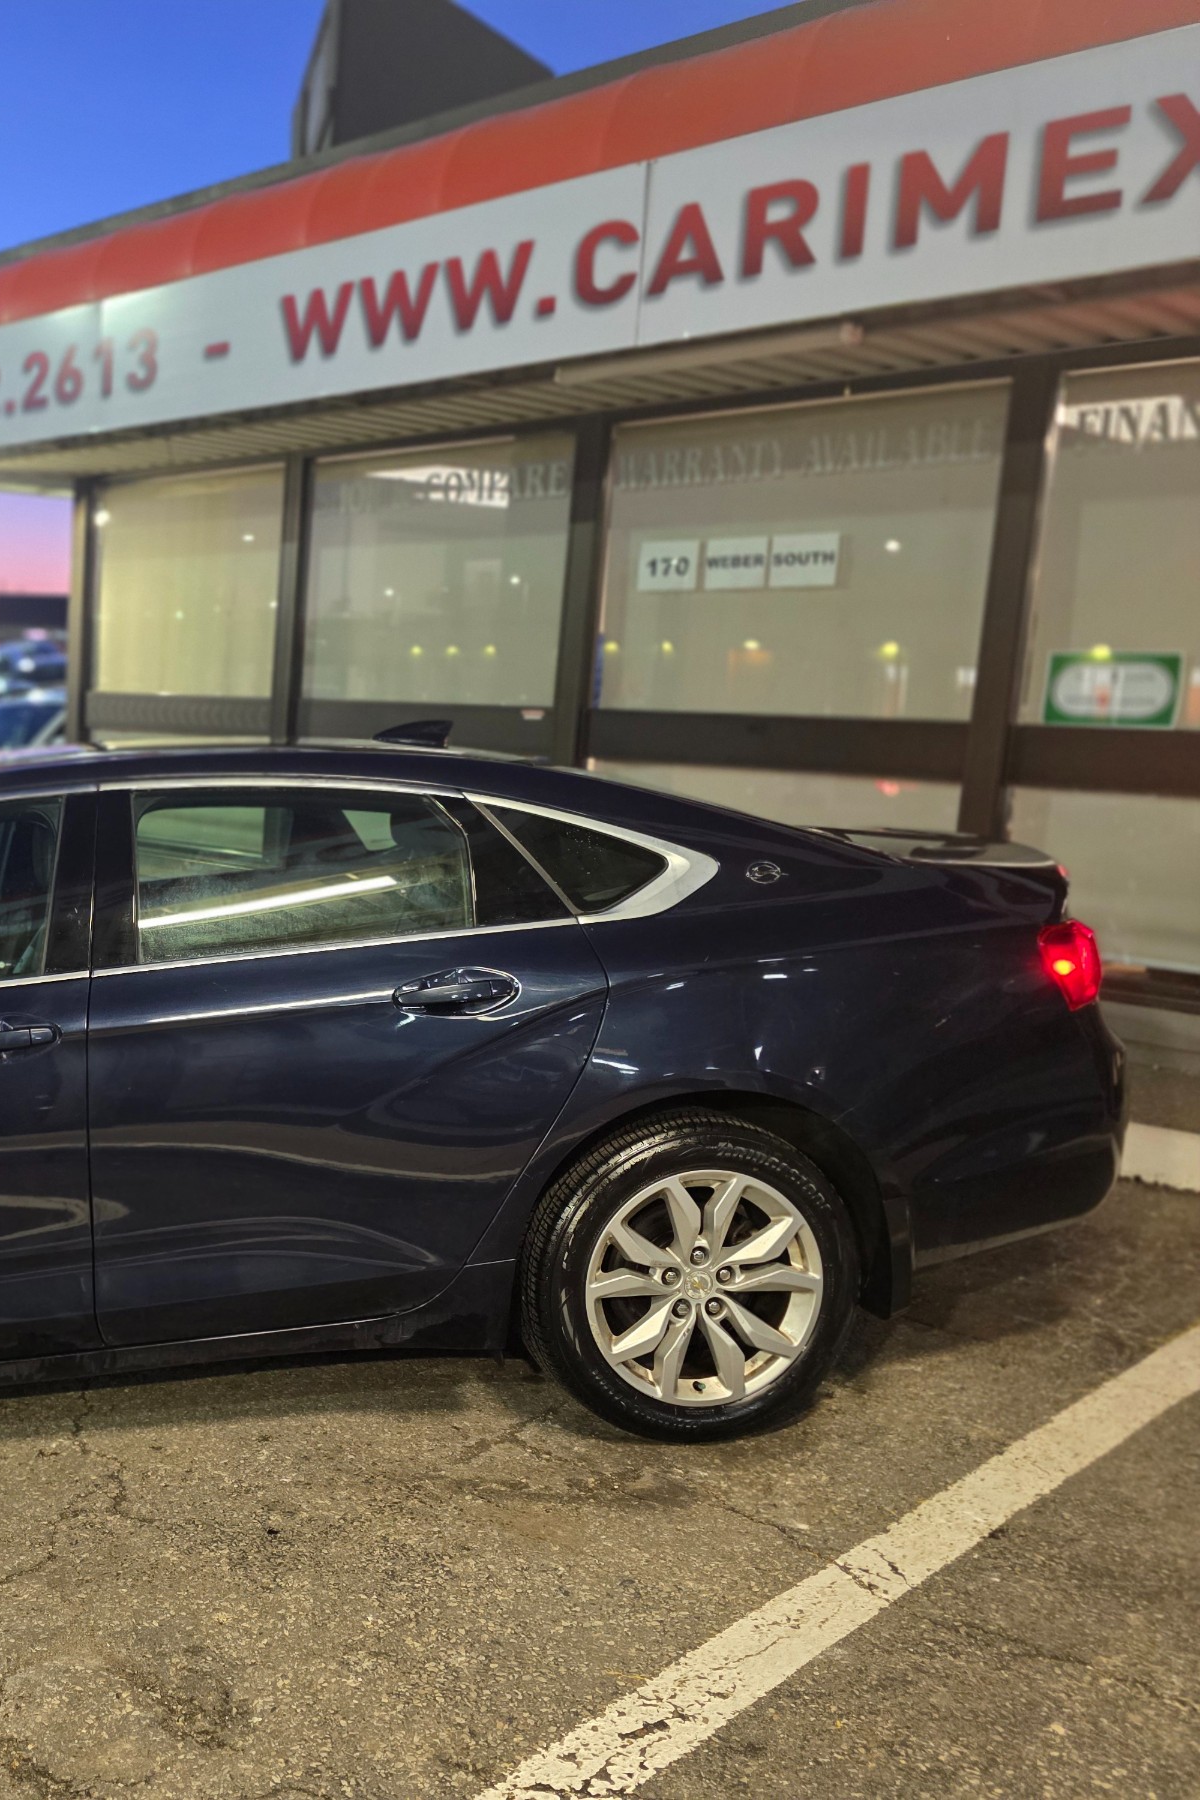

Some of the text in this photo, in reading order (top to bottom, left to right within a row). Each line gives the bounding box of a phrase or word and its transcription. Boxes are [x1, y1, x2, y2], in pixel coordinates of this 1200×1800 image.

[616, 418, 993, 490] WARRANTY AVAILABLE
[426, 461, 568, 505] COMPARE
[646, 551, 836, 577] 170 WEBER SOUTH
